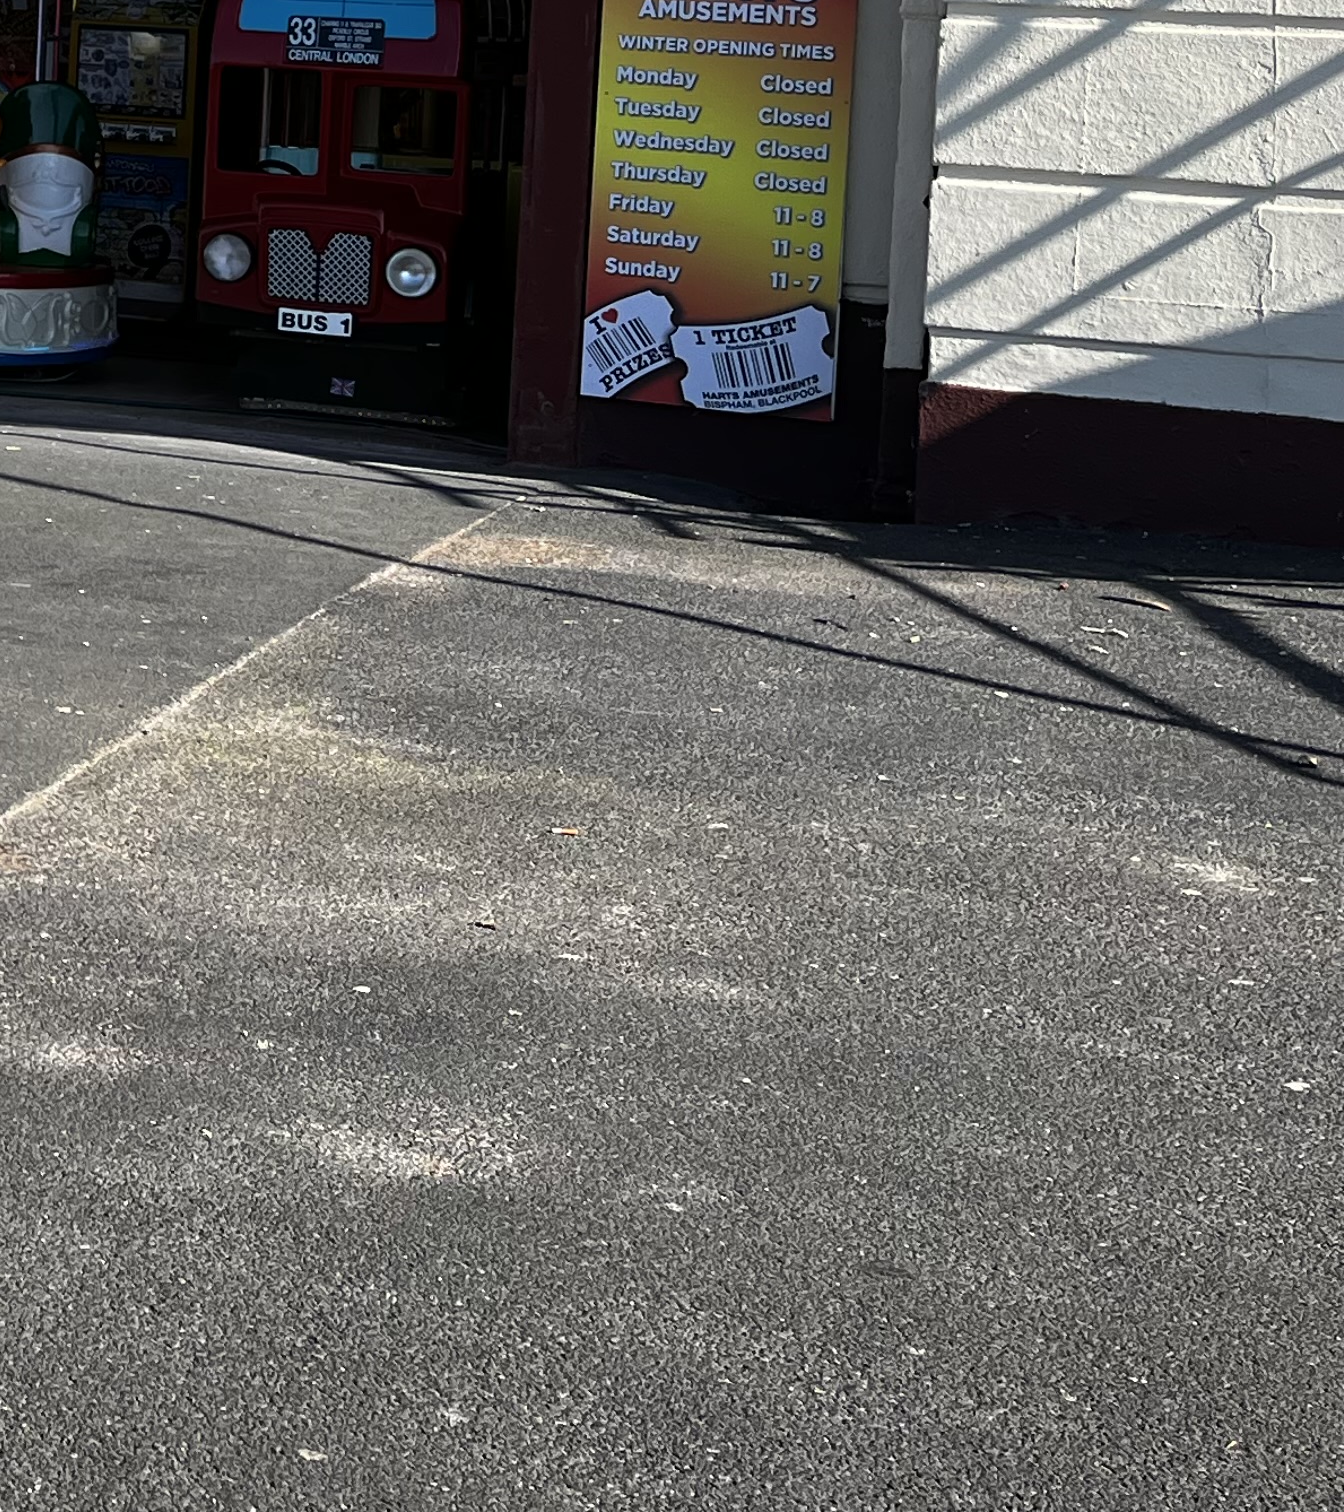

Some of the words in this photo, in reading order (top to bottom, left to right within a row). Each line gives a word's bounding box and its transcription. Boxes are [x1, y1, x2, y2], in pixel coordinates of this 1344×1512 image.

[638, 0, 817, 27] AMUSEMENTS
[288, 16, 317, 46] 33
[287, 49, 333, 63] CENTRAL
[336, 51, 380, 65] LONDON
[618, 34, 688, 53] WINTER
[693, 38, 775, 58] OPENING
[780, 43, 835, 61] TIMES
[615, 66, 698, 90] Monday
[760, 74, 833, 96] Closed
[614, 97, 701, 122] Tuesday
[758, 106, 831, 128] Closed
[613, 129, 734, 158] Wednesday
[755, 139, 829, 161] Closed
[611, 161, 706, 187] Thursday
[753, 172, 827, 194] Closed
[608, 193, 674, 218] Friday
[772, 206, 792, 224] 11
[810, 209, 825, 227] 8
[606, 225, 700, 252] Saturday
[771, 239, 790, 257] 11
[807, 242, 823, 260] 8
[604, 256, 681, 283] Sunday
[769, 272, 788, 290] 11
[806, 274, 821, 292] 7
[281, 311, 328, 332] BUS
[339, 318, 350, 334] 1
[589, 315, 607, 335] I
[693, 330, 706, 346] 1
[711, 316, 797, 345] TICKET
[598, 343, 673, 393] PRIZES
[701, 391, 740, 400] HARTS
[742, 374, 820, 400] AMUSEMENTS
[703, 399, 756, 409] BISPHAM,
[757, 385, 823, 408] BLACKPOOL
